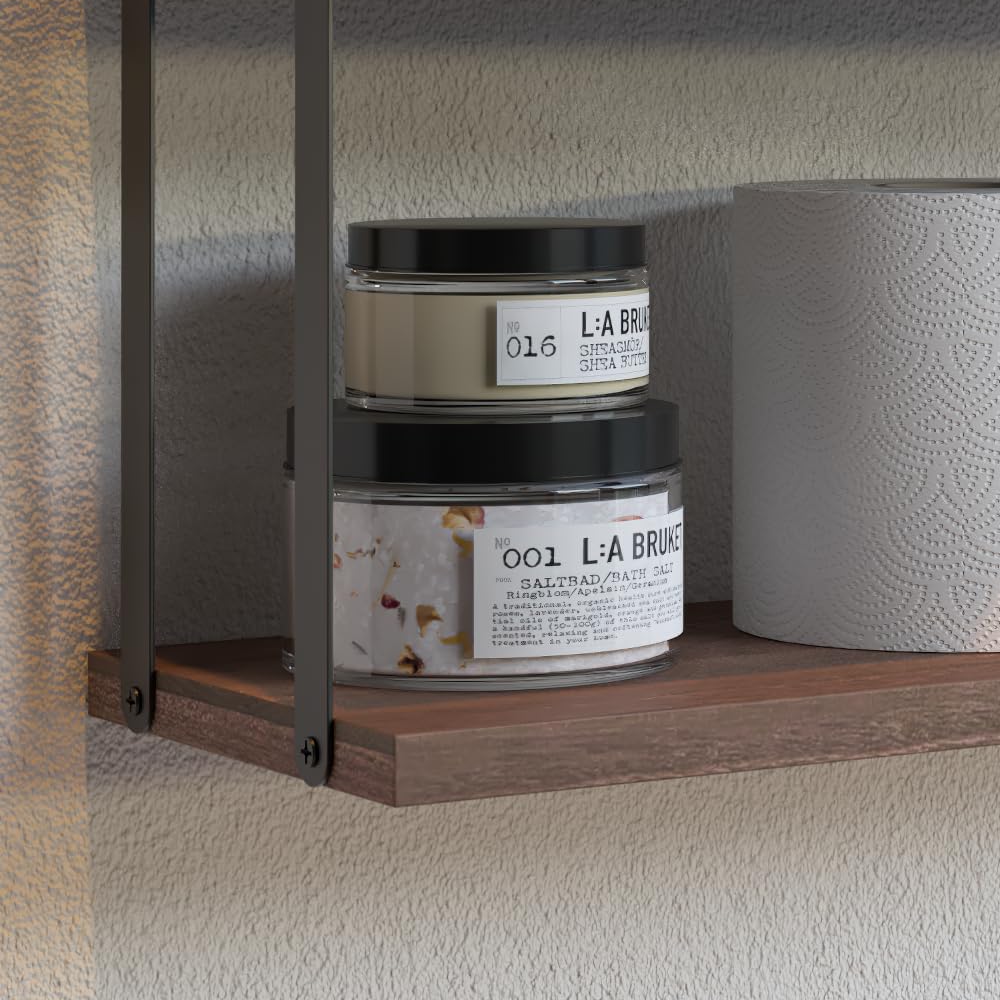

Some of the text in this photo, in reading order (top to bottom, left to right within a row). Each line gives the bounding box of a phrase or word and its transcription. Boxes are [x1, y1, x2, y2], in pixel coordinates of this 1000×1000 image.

[582, 309, 615, 338] L:A
[506, 335, 556, 358] 016
[579, 357, 617, 372] SHEA
[502, 546, 562, 569] 001
[582, 535, 624, 565] L:A
[520, 568, 646, 590] SALTBAD/BATH
